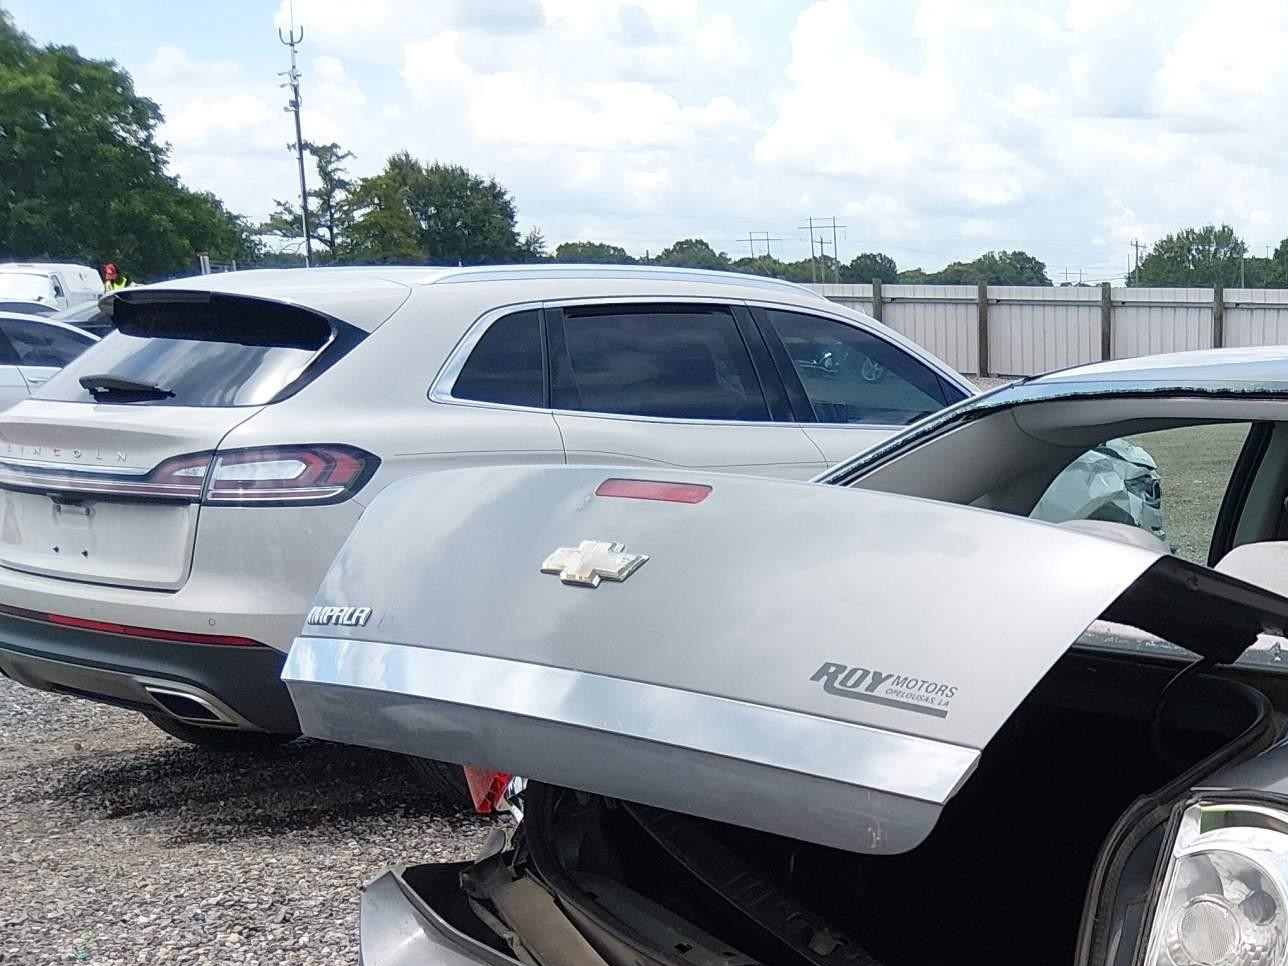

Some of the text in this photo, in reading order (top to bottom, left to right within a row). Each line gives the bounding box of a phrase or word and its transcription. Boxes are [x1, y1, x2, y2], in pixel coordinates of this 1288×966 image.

[7, 444, 128, 462] LINCOLN
[306, 606, 373, 627] IMPALA
[810, 662, 958, 698] ROY MOTORS
[937, 699, 949, 707] LA
